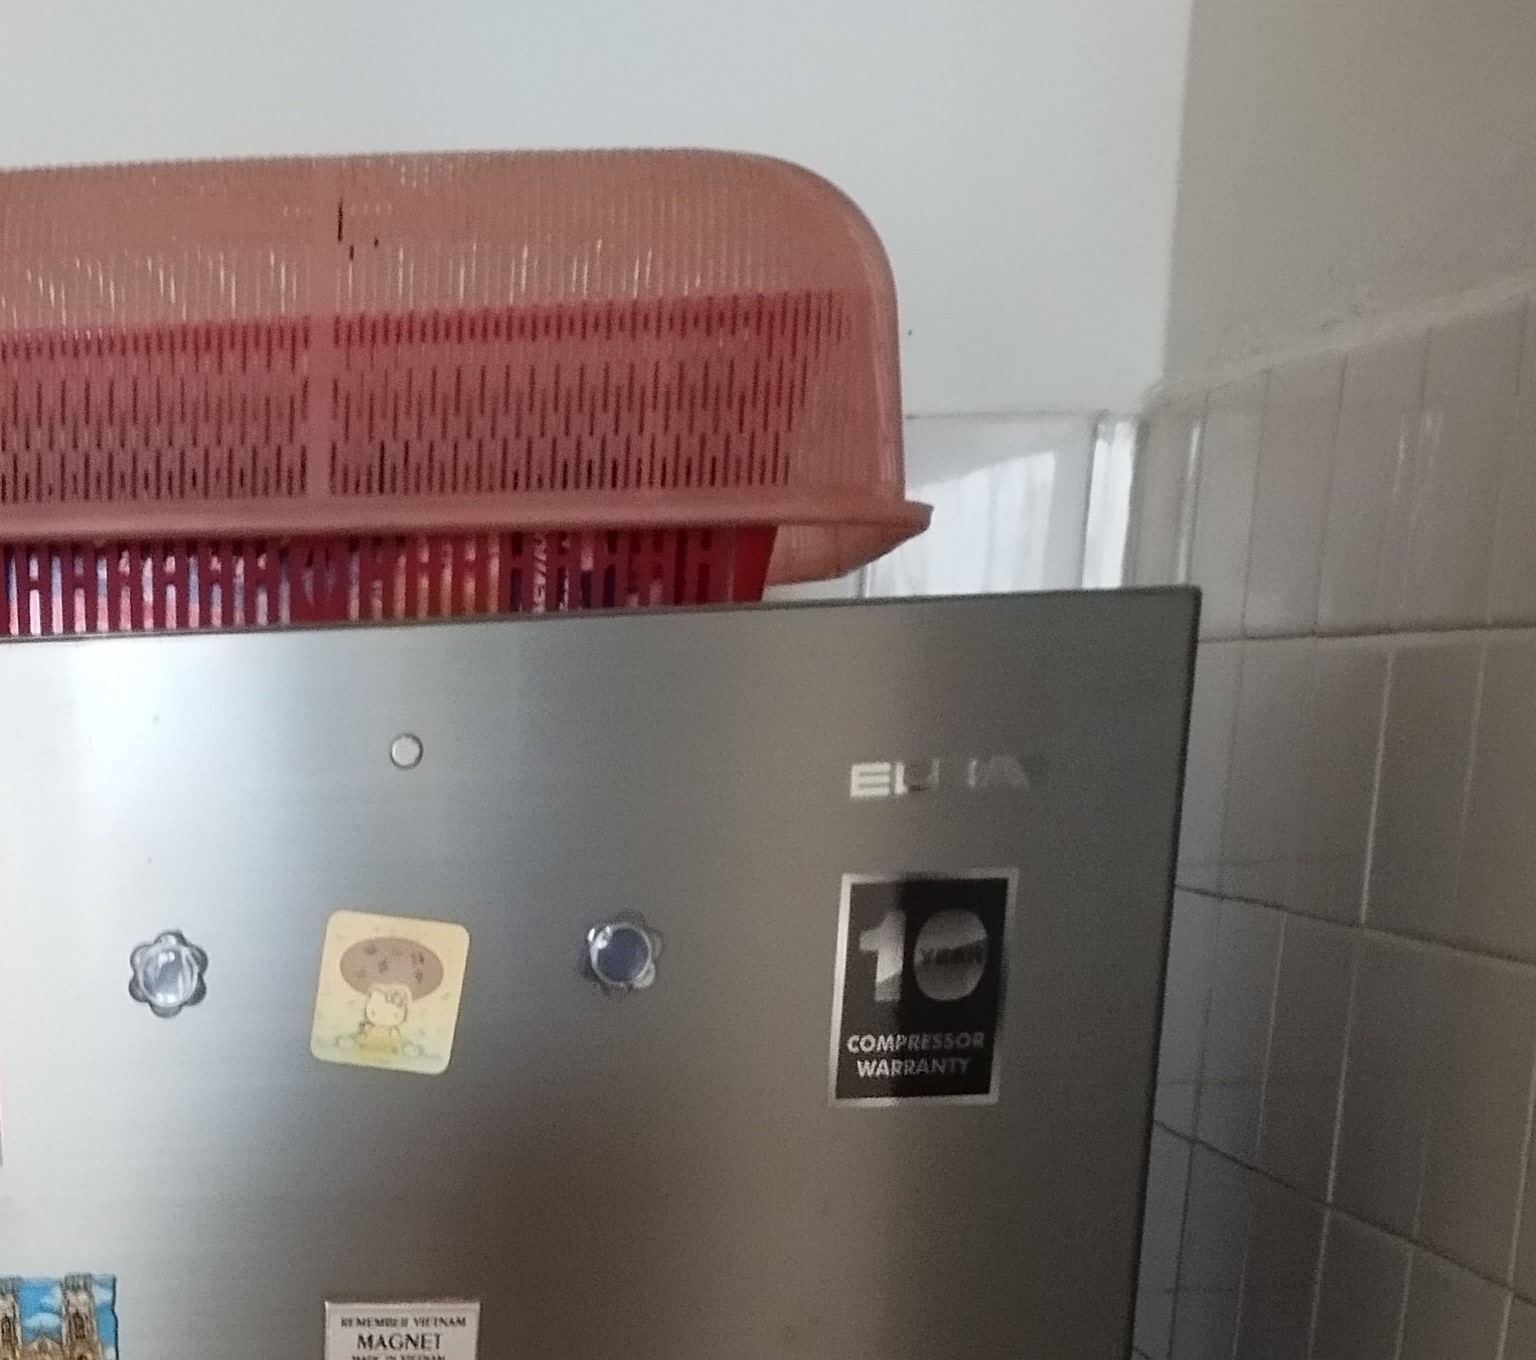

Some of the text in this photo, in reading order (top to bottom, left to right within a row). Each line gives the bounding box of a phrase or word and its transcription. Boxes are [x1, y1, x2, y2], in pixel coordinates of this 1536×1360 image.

[847, 1032, 985, 1053] COMPRESSOR
[857, 1057, 970, 1078] WARRANTY
[413, 1315, 467, 1328] VIETNAM
[357, 1332, 442, 1350] MAGNET
